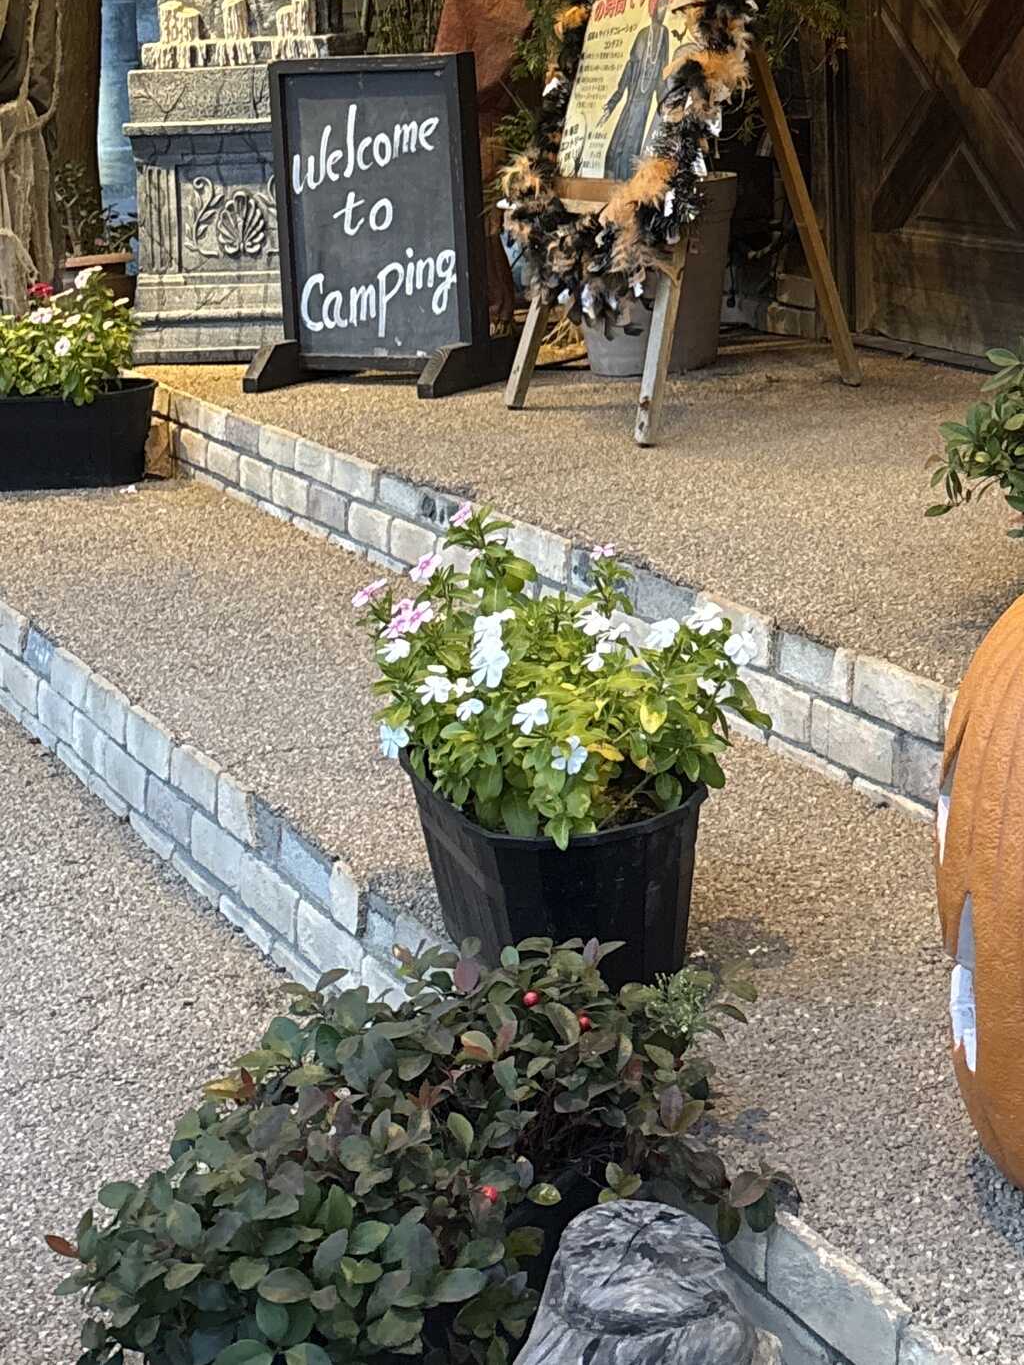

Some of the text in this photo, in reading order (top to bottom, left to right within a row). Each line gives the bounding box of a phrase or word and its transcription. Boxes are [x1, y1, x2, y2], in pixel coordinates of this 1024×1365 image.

[292, 104, 439, 194] Welcome
[333, 191, 393, 236] to
[300, 248, 457, 338] Camping
